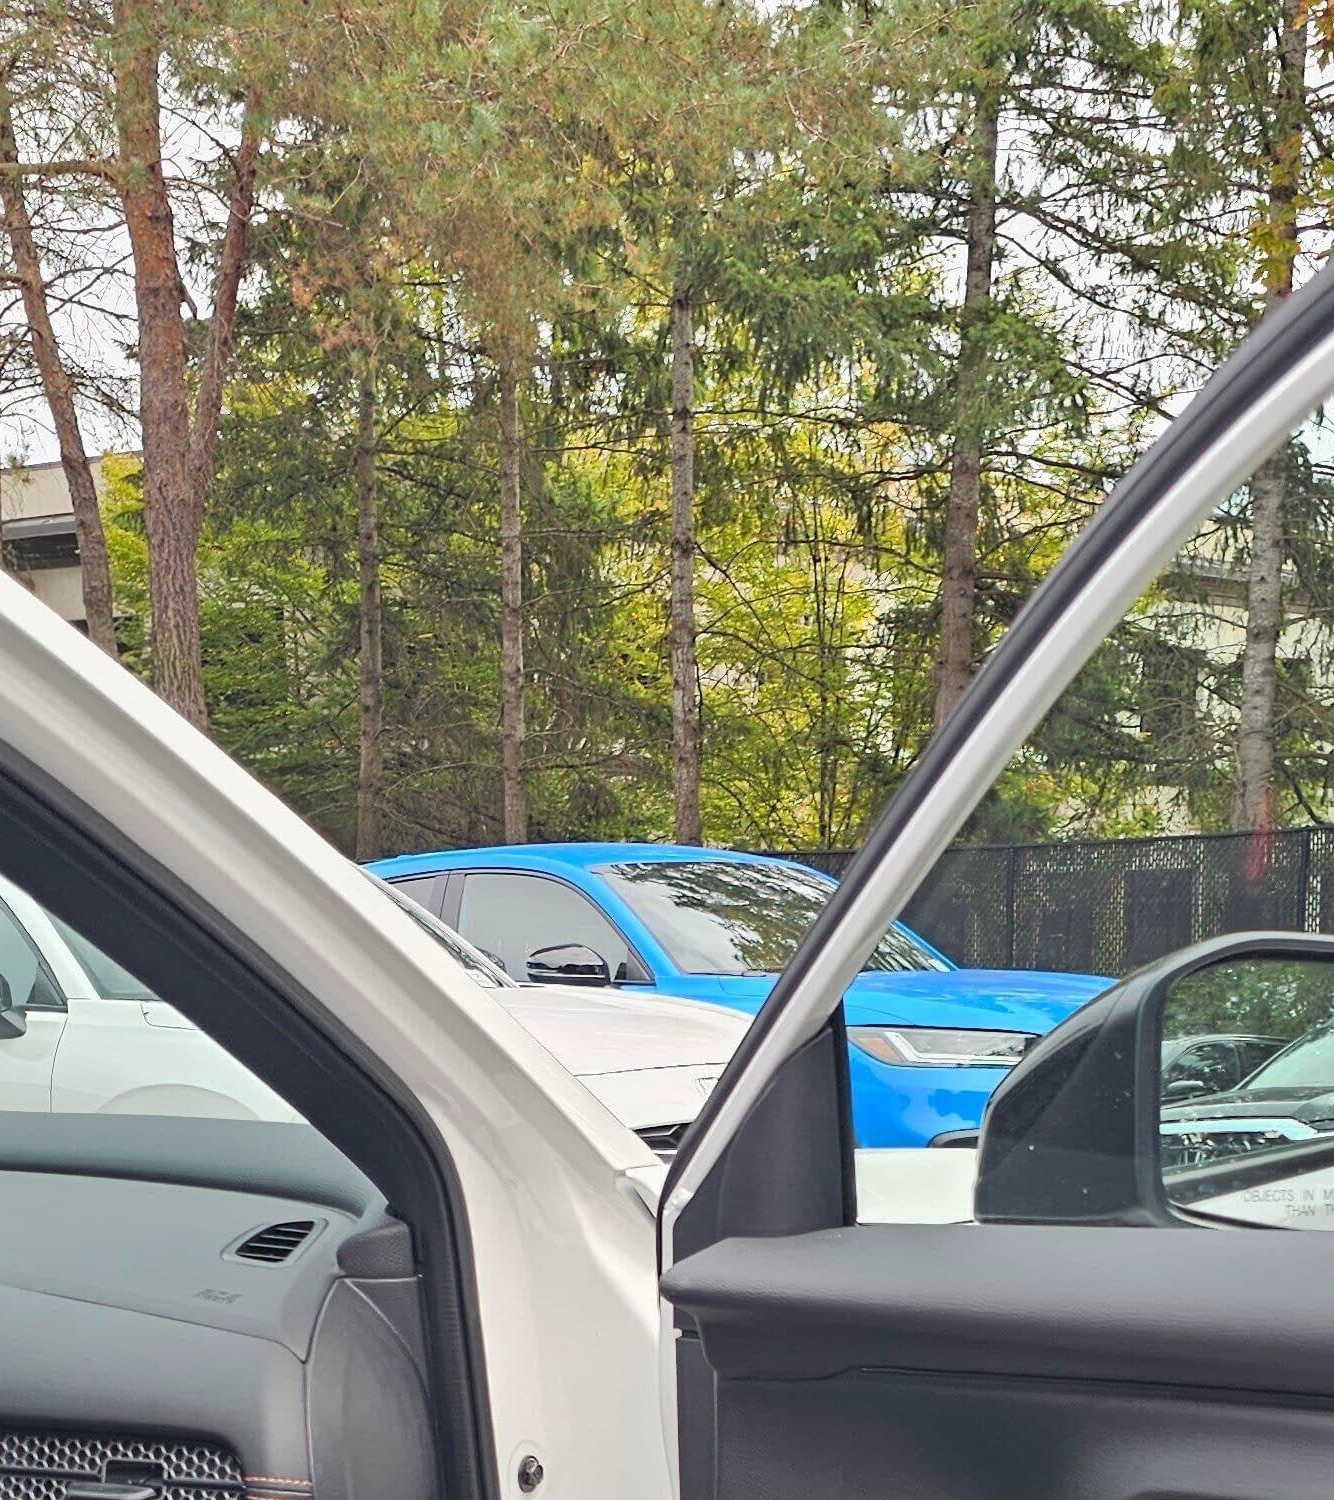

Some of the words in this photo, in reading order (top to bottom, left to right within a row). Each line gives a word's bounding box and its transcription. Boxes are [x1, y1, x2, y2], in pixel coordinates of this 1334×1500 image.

[1243, 1189, 1293, 1202] OBJECTS
[1302, 1189, 1315, 1201] IN
[1286, 1204, 1315, 1216] THAN
